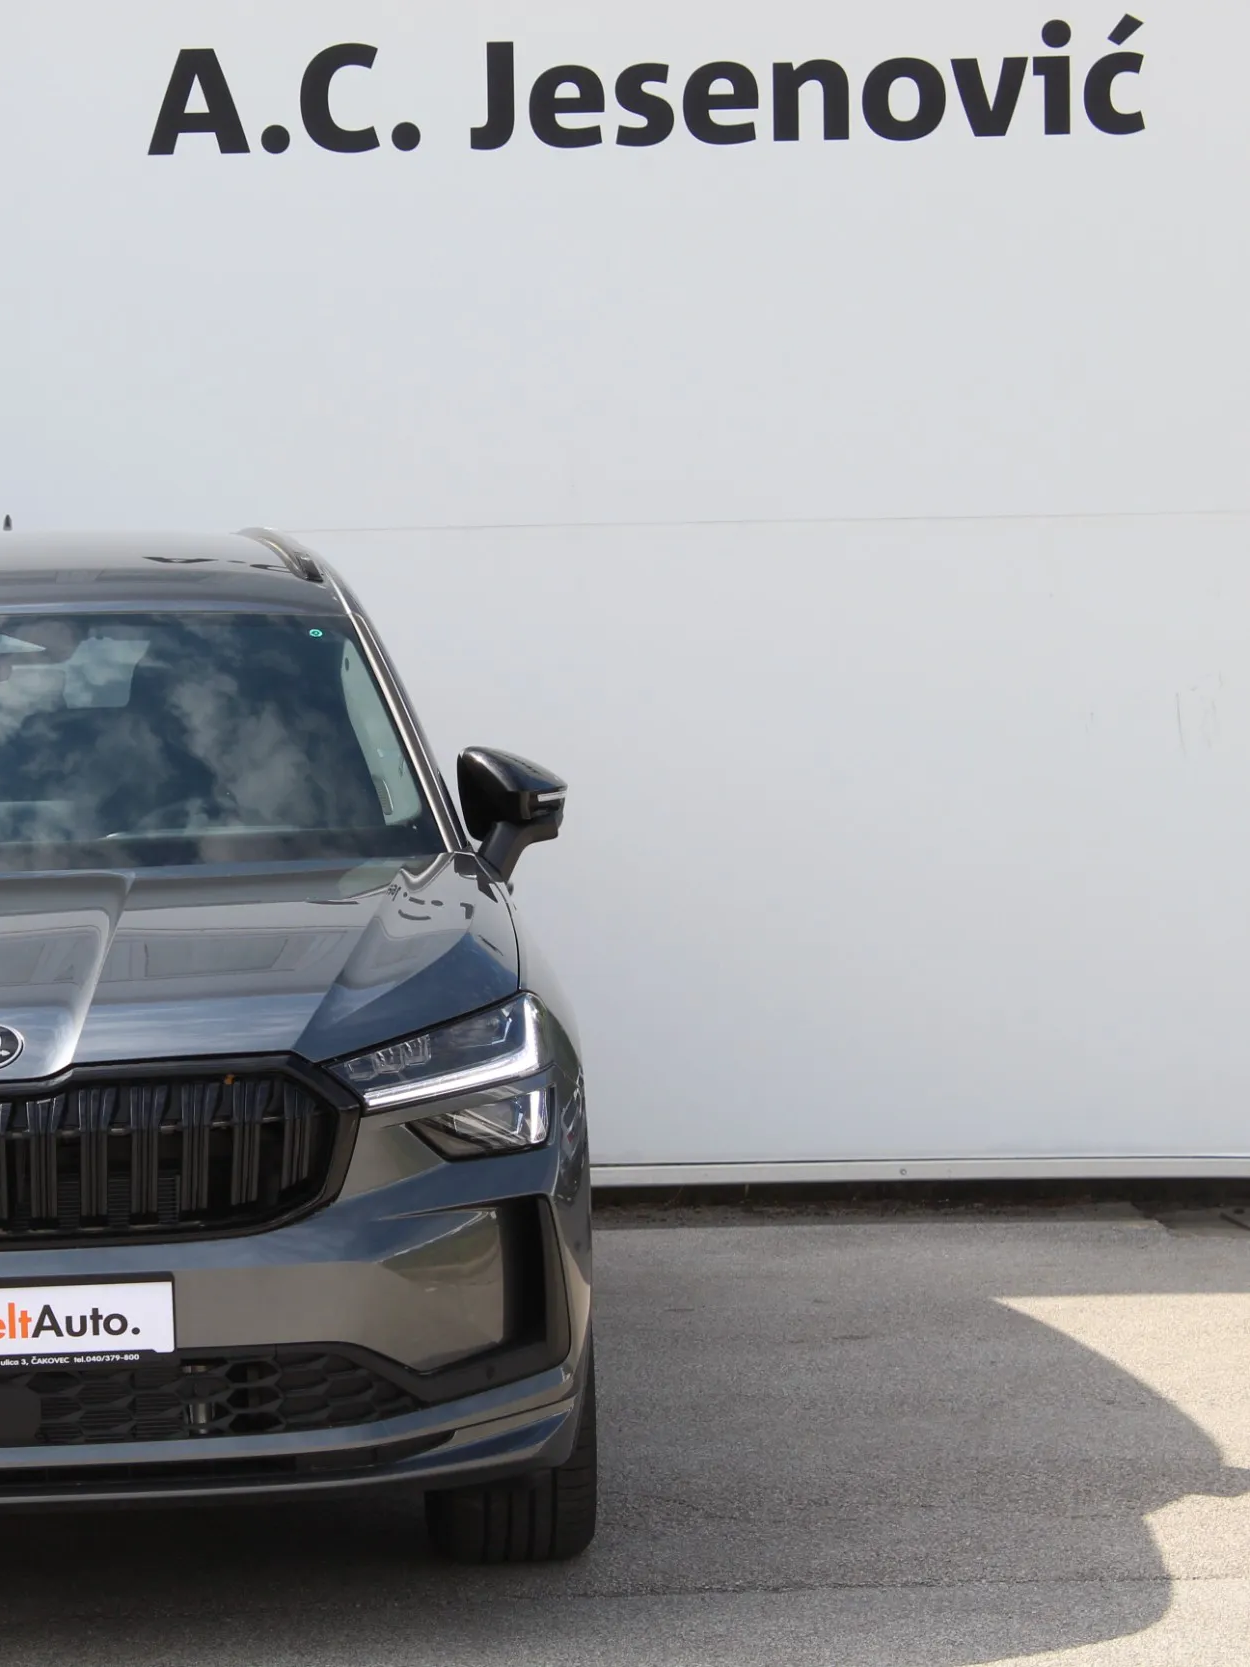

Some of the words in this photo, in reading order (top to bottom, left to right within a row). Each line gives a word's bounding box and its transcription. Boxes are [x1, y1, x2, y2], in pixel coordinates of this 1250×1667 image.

[147, 42, 421, 156] A.C.
[469, 13, 1146, 151] Jesenović
[0, 1358, 20, 1367] ulica
[30, 1354, 70, 1366] ČAKOVEC
